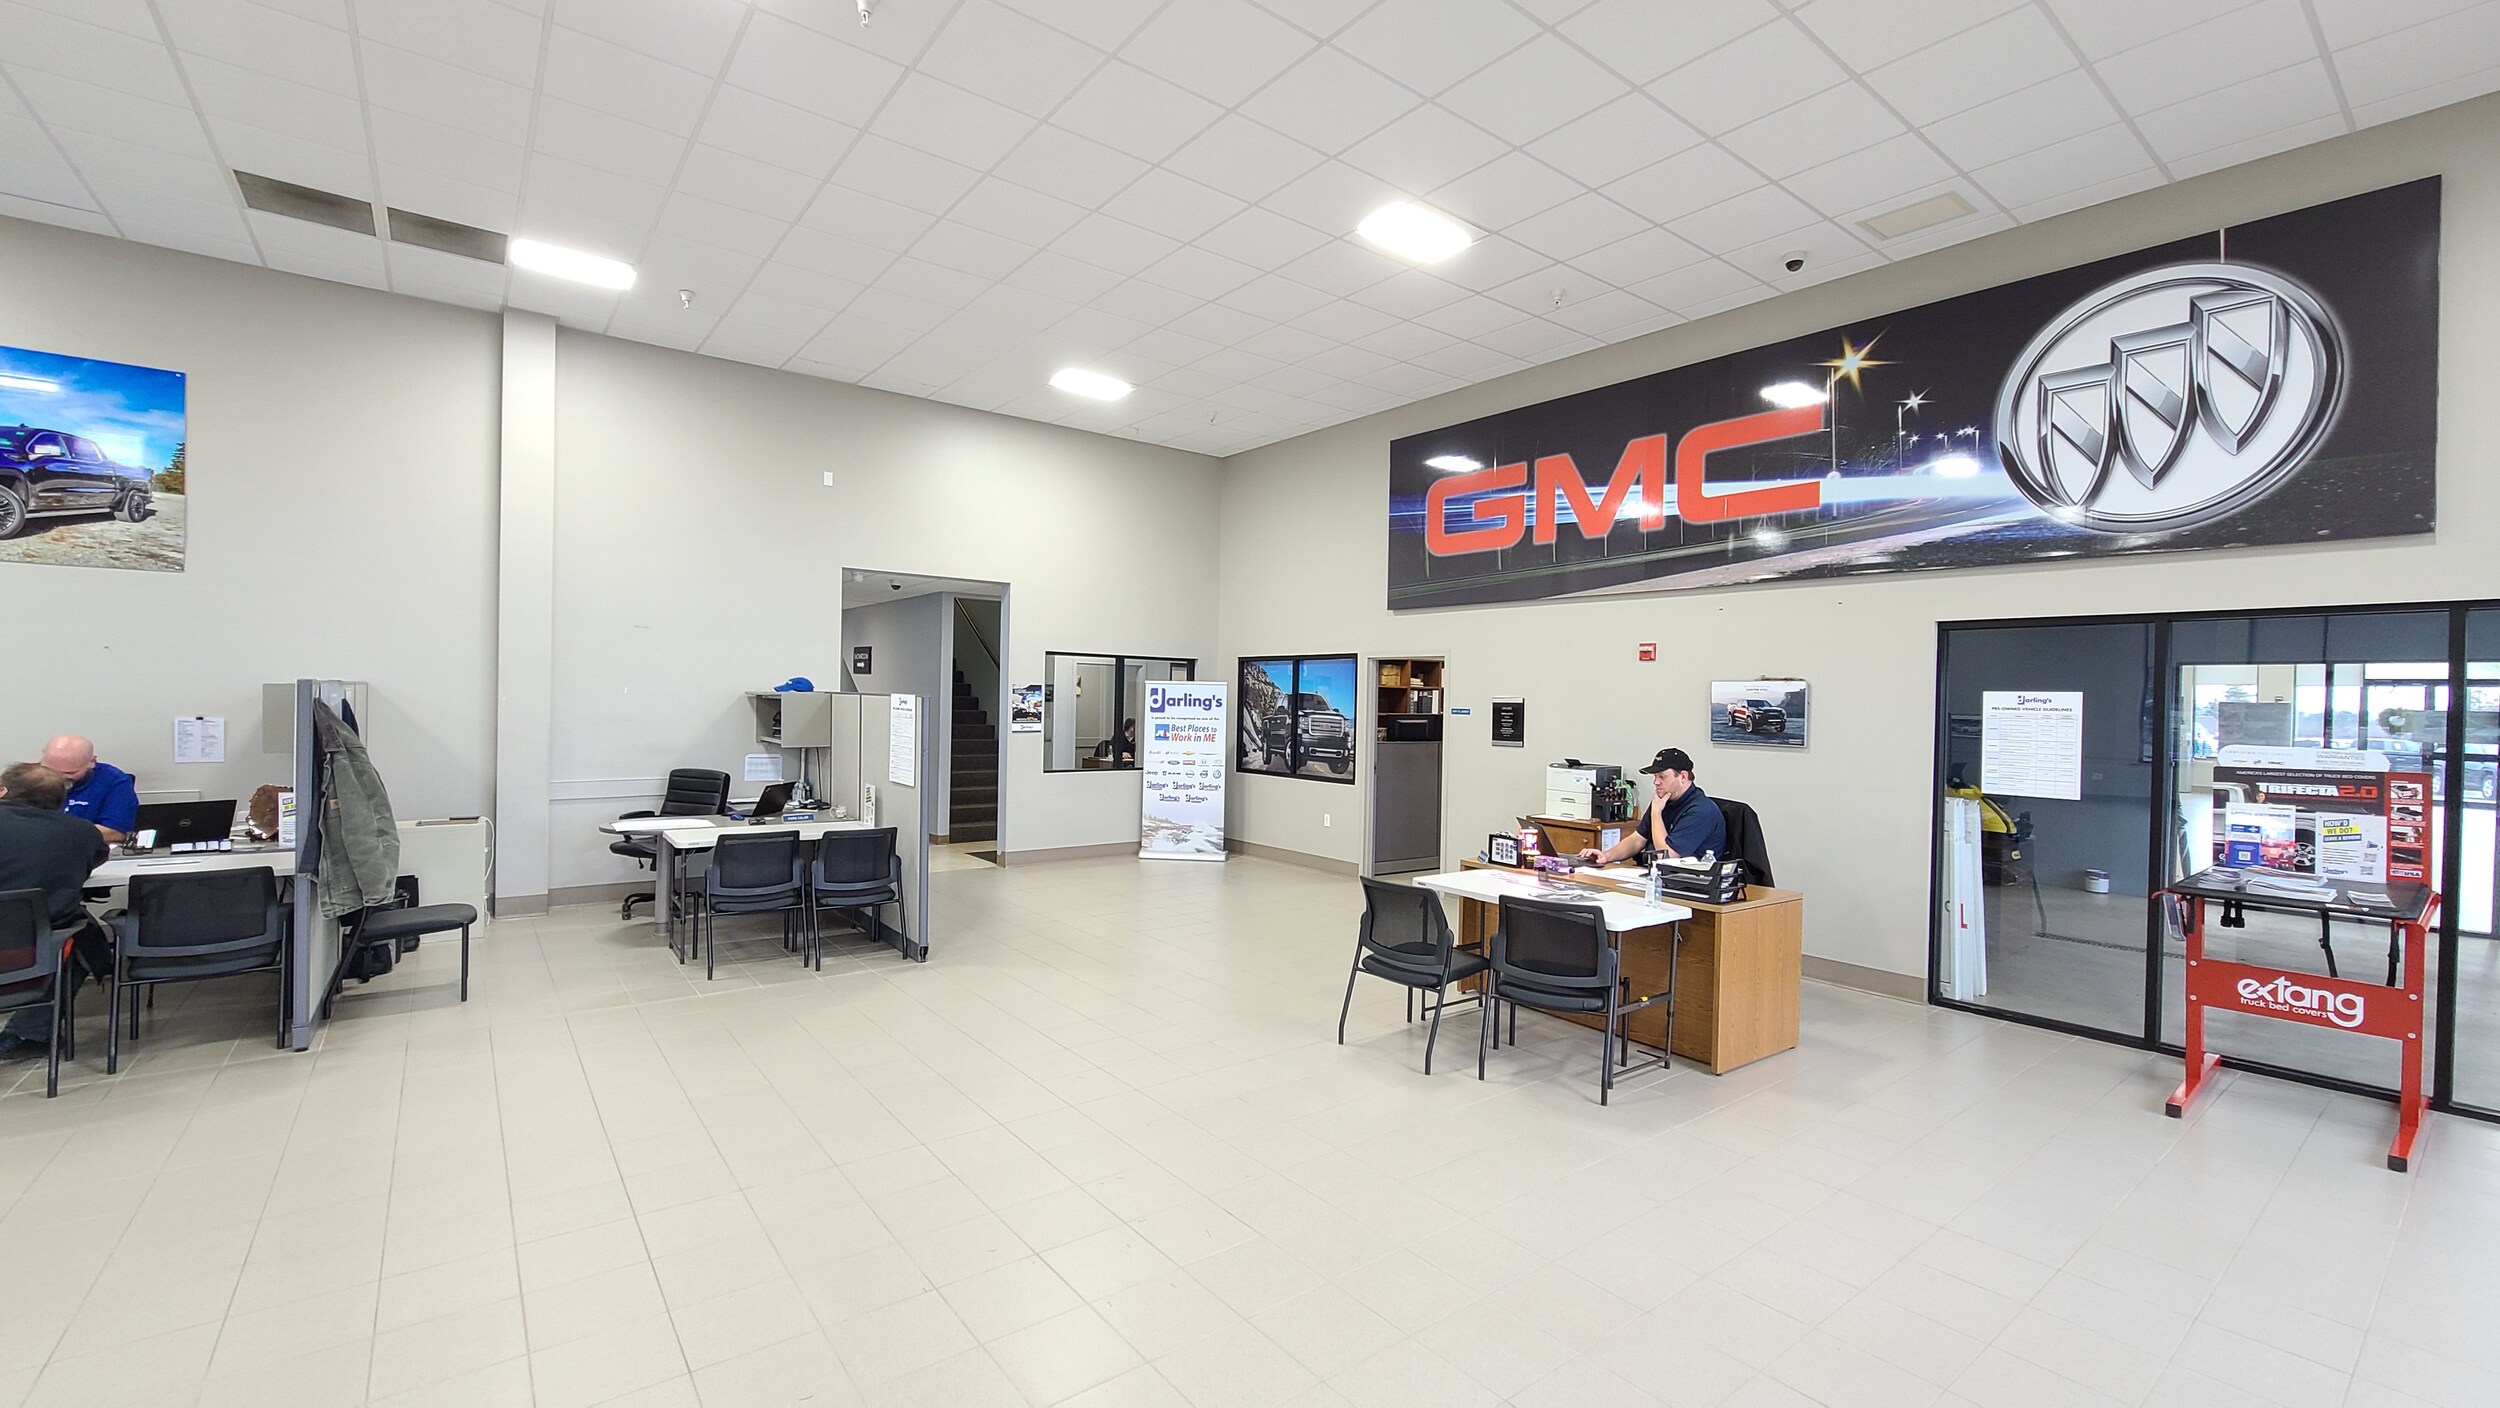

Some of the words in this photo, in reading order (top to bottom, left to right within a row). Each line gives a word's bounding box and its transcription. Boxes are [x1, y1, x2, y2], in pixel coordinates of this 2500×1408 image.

[1426, 403, 1824, 557] GMC
[1171, 723, 1186, 732] Best
[1187, 724, 1210, 733] Places
[1171, 732, 1193, 742] Work
[1193, 732, 1202, 742] in
[1203, 733, 1217, 743] ME
[2255, 782, 2339, 797] TRIFECTA
[2338, 785, 2378, 799] 2.0
[2237, 976, 2365, 1028] extang
[2240, 997, 2267, 1008] truck
[2268, 1001, 2290, 1012] bed
[2292, 1006, 2328, 1018] covers
